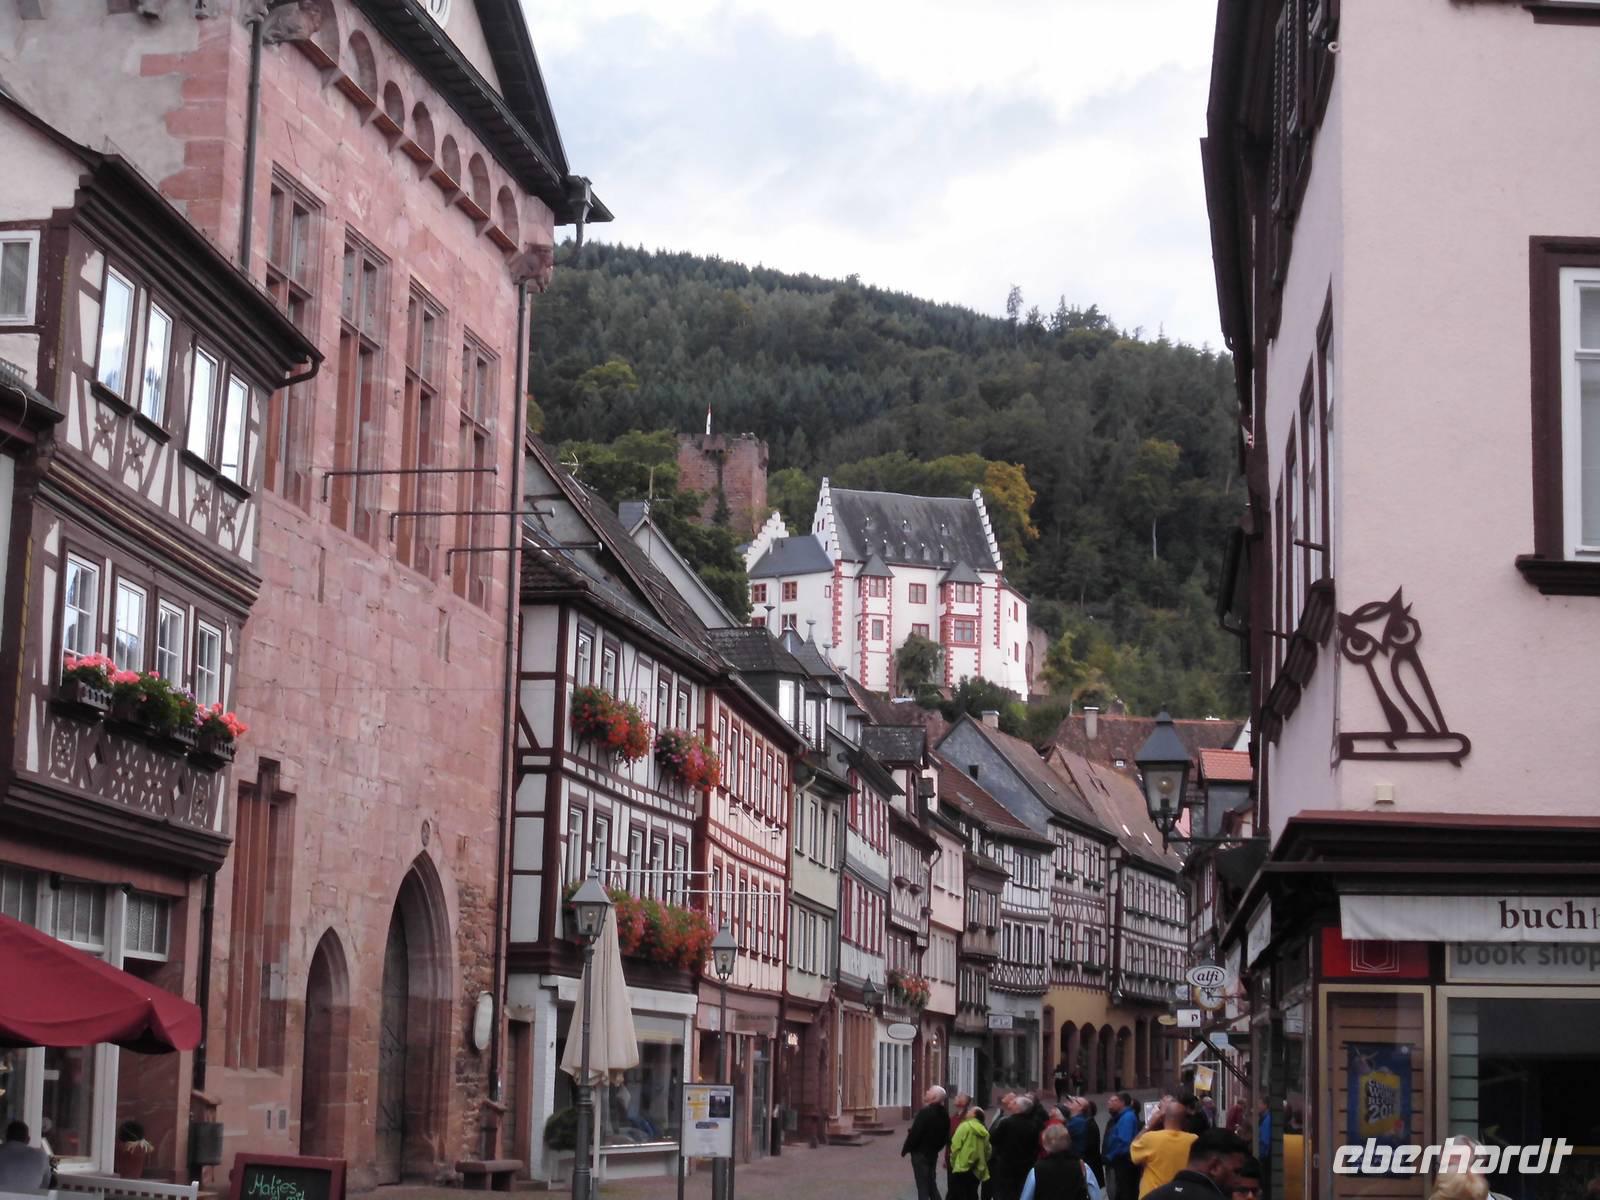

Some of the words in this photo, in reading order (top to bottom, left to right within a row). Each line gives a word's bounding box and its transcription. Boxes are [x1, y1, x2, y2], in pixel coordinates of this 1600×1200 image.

[1456, 942, 1526, 966] book
[1197, 971, 1219, 986] alfi
[248, 1172, 297, 1200] Matjes
